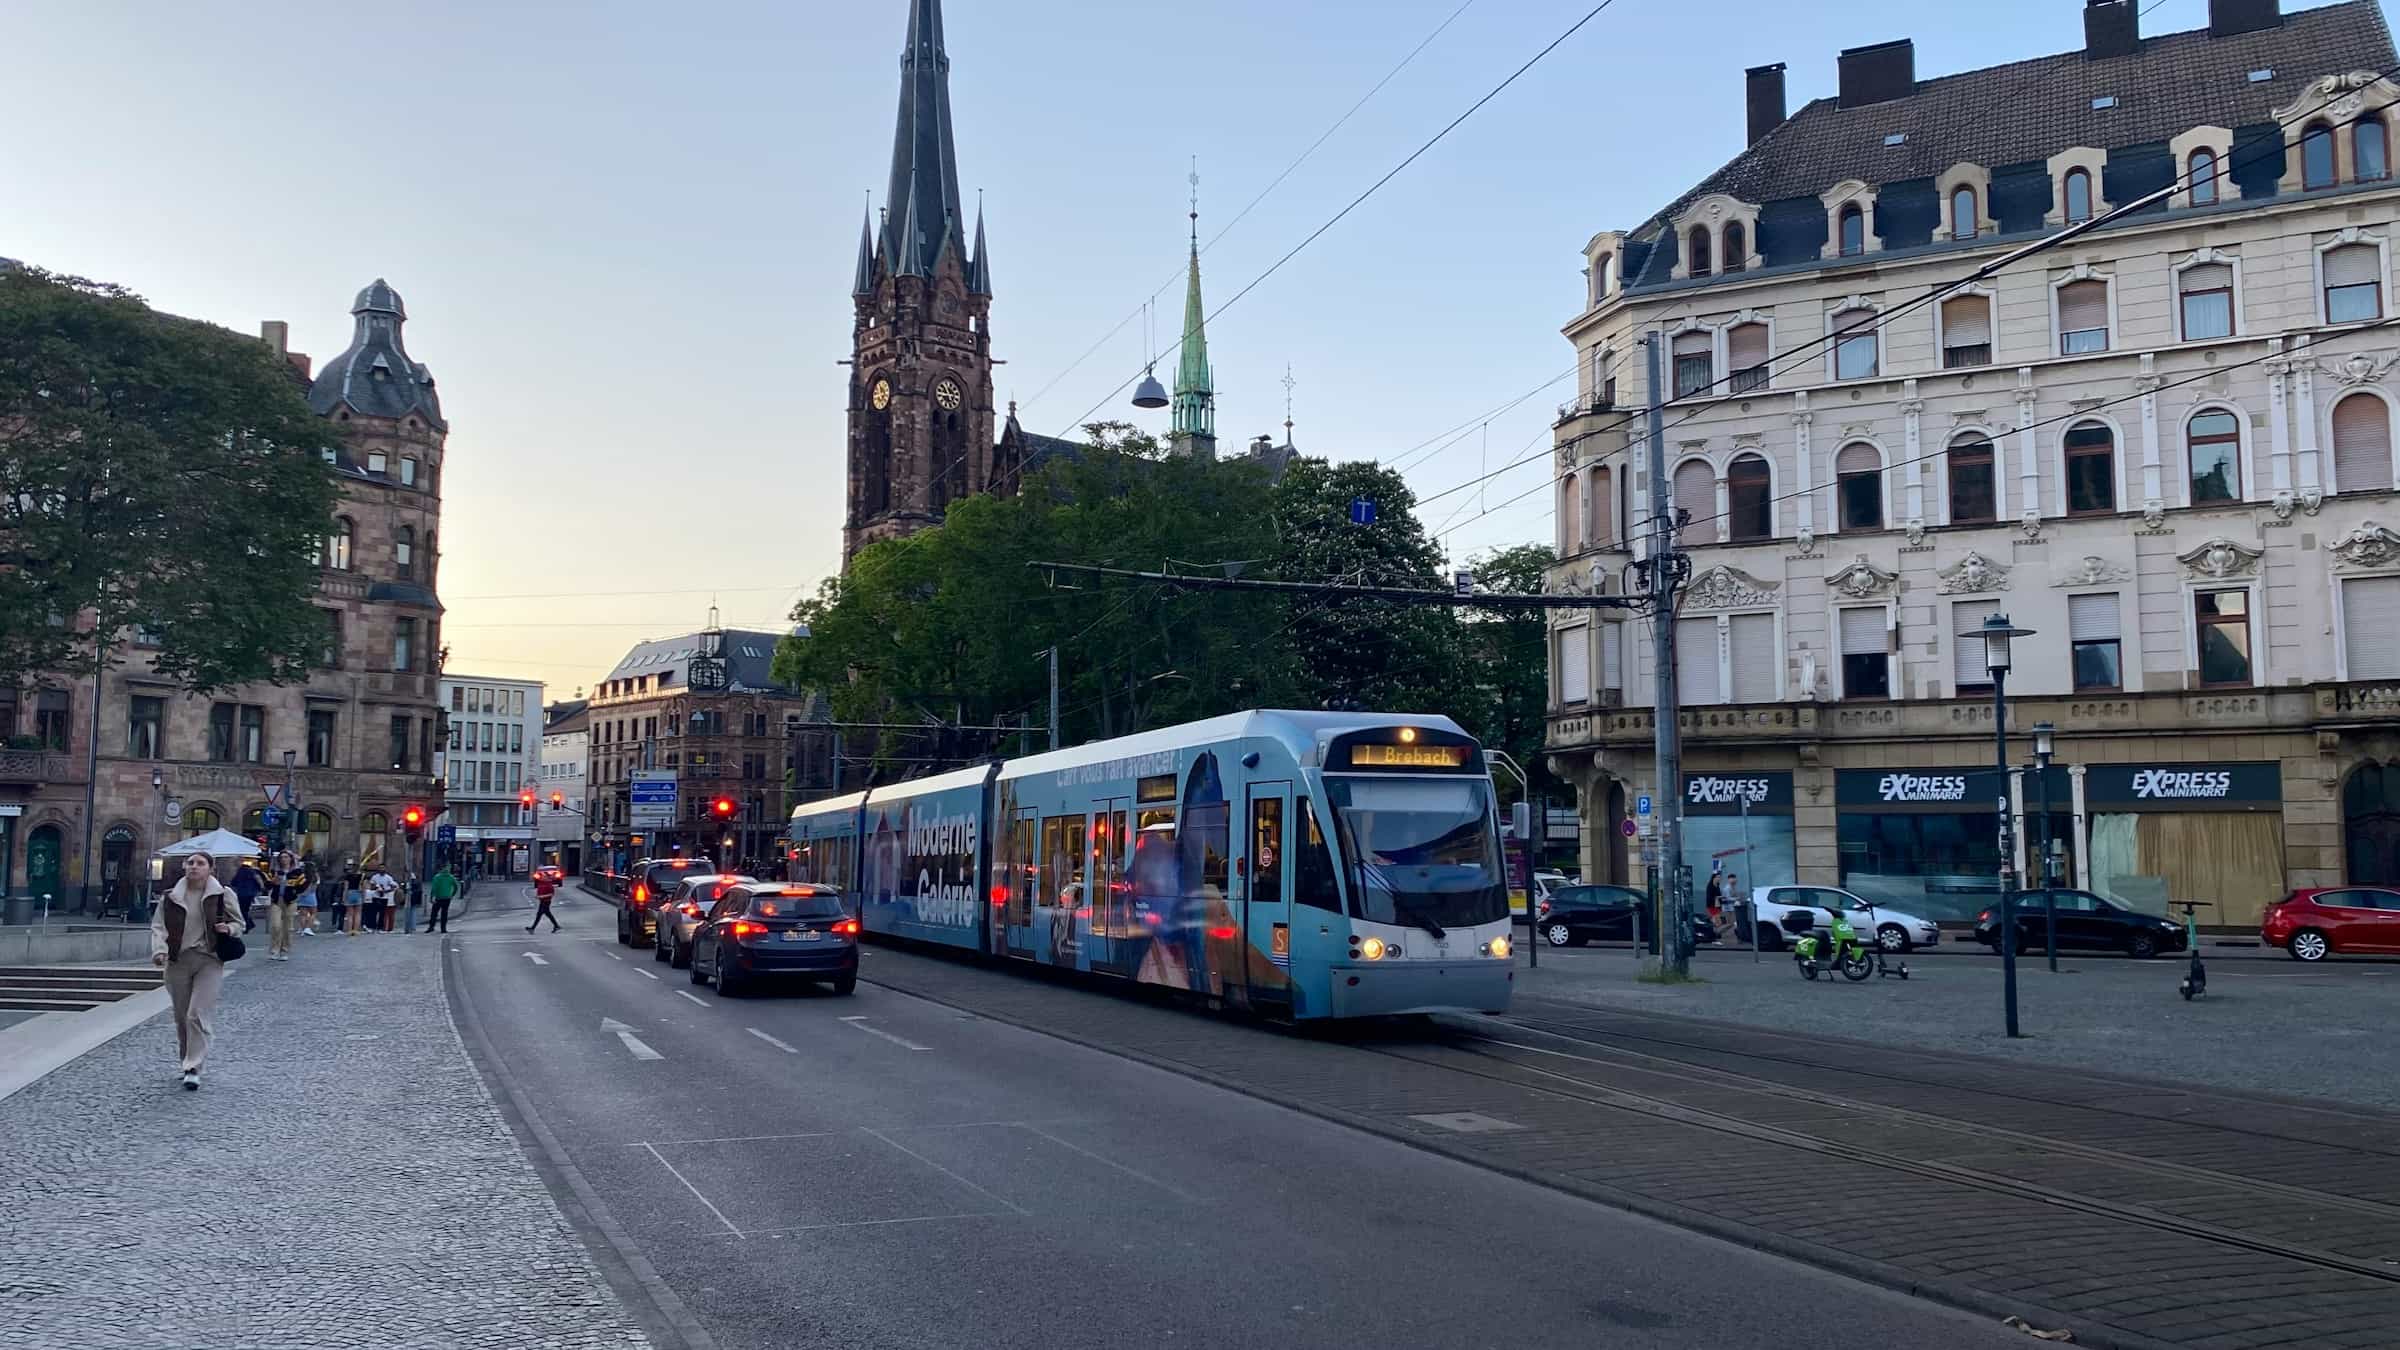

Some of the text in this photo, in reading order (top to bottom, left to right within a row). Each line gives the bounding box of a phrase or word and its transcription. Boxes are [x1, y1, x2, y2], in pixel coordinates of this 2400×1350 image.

[1126, 750, 1175, 778] avancer
[1385, 746, 1451, 765] Brebach
[1688, 777, 1768, 802] EXPRESS
[1879, 774, 1966, 800] EXPRESS
[1907, 791, 1966, 800] MINIMARKT
[2132, 769, 2231, 797] EXPRESS
[2163, 787, 2231, 797] MINIMARKT
[908, 801, 976, 857] Moderne
[917, 867, 974, 928] Galerie
